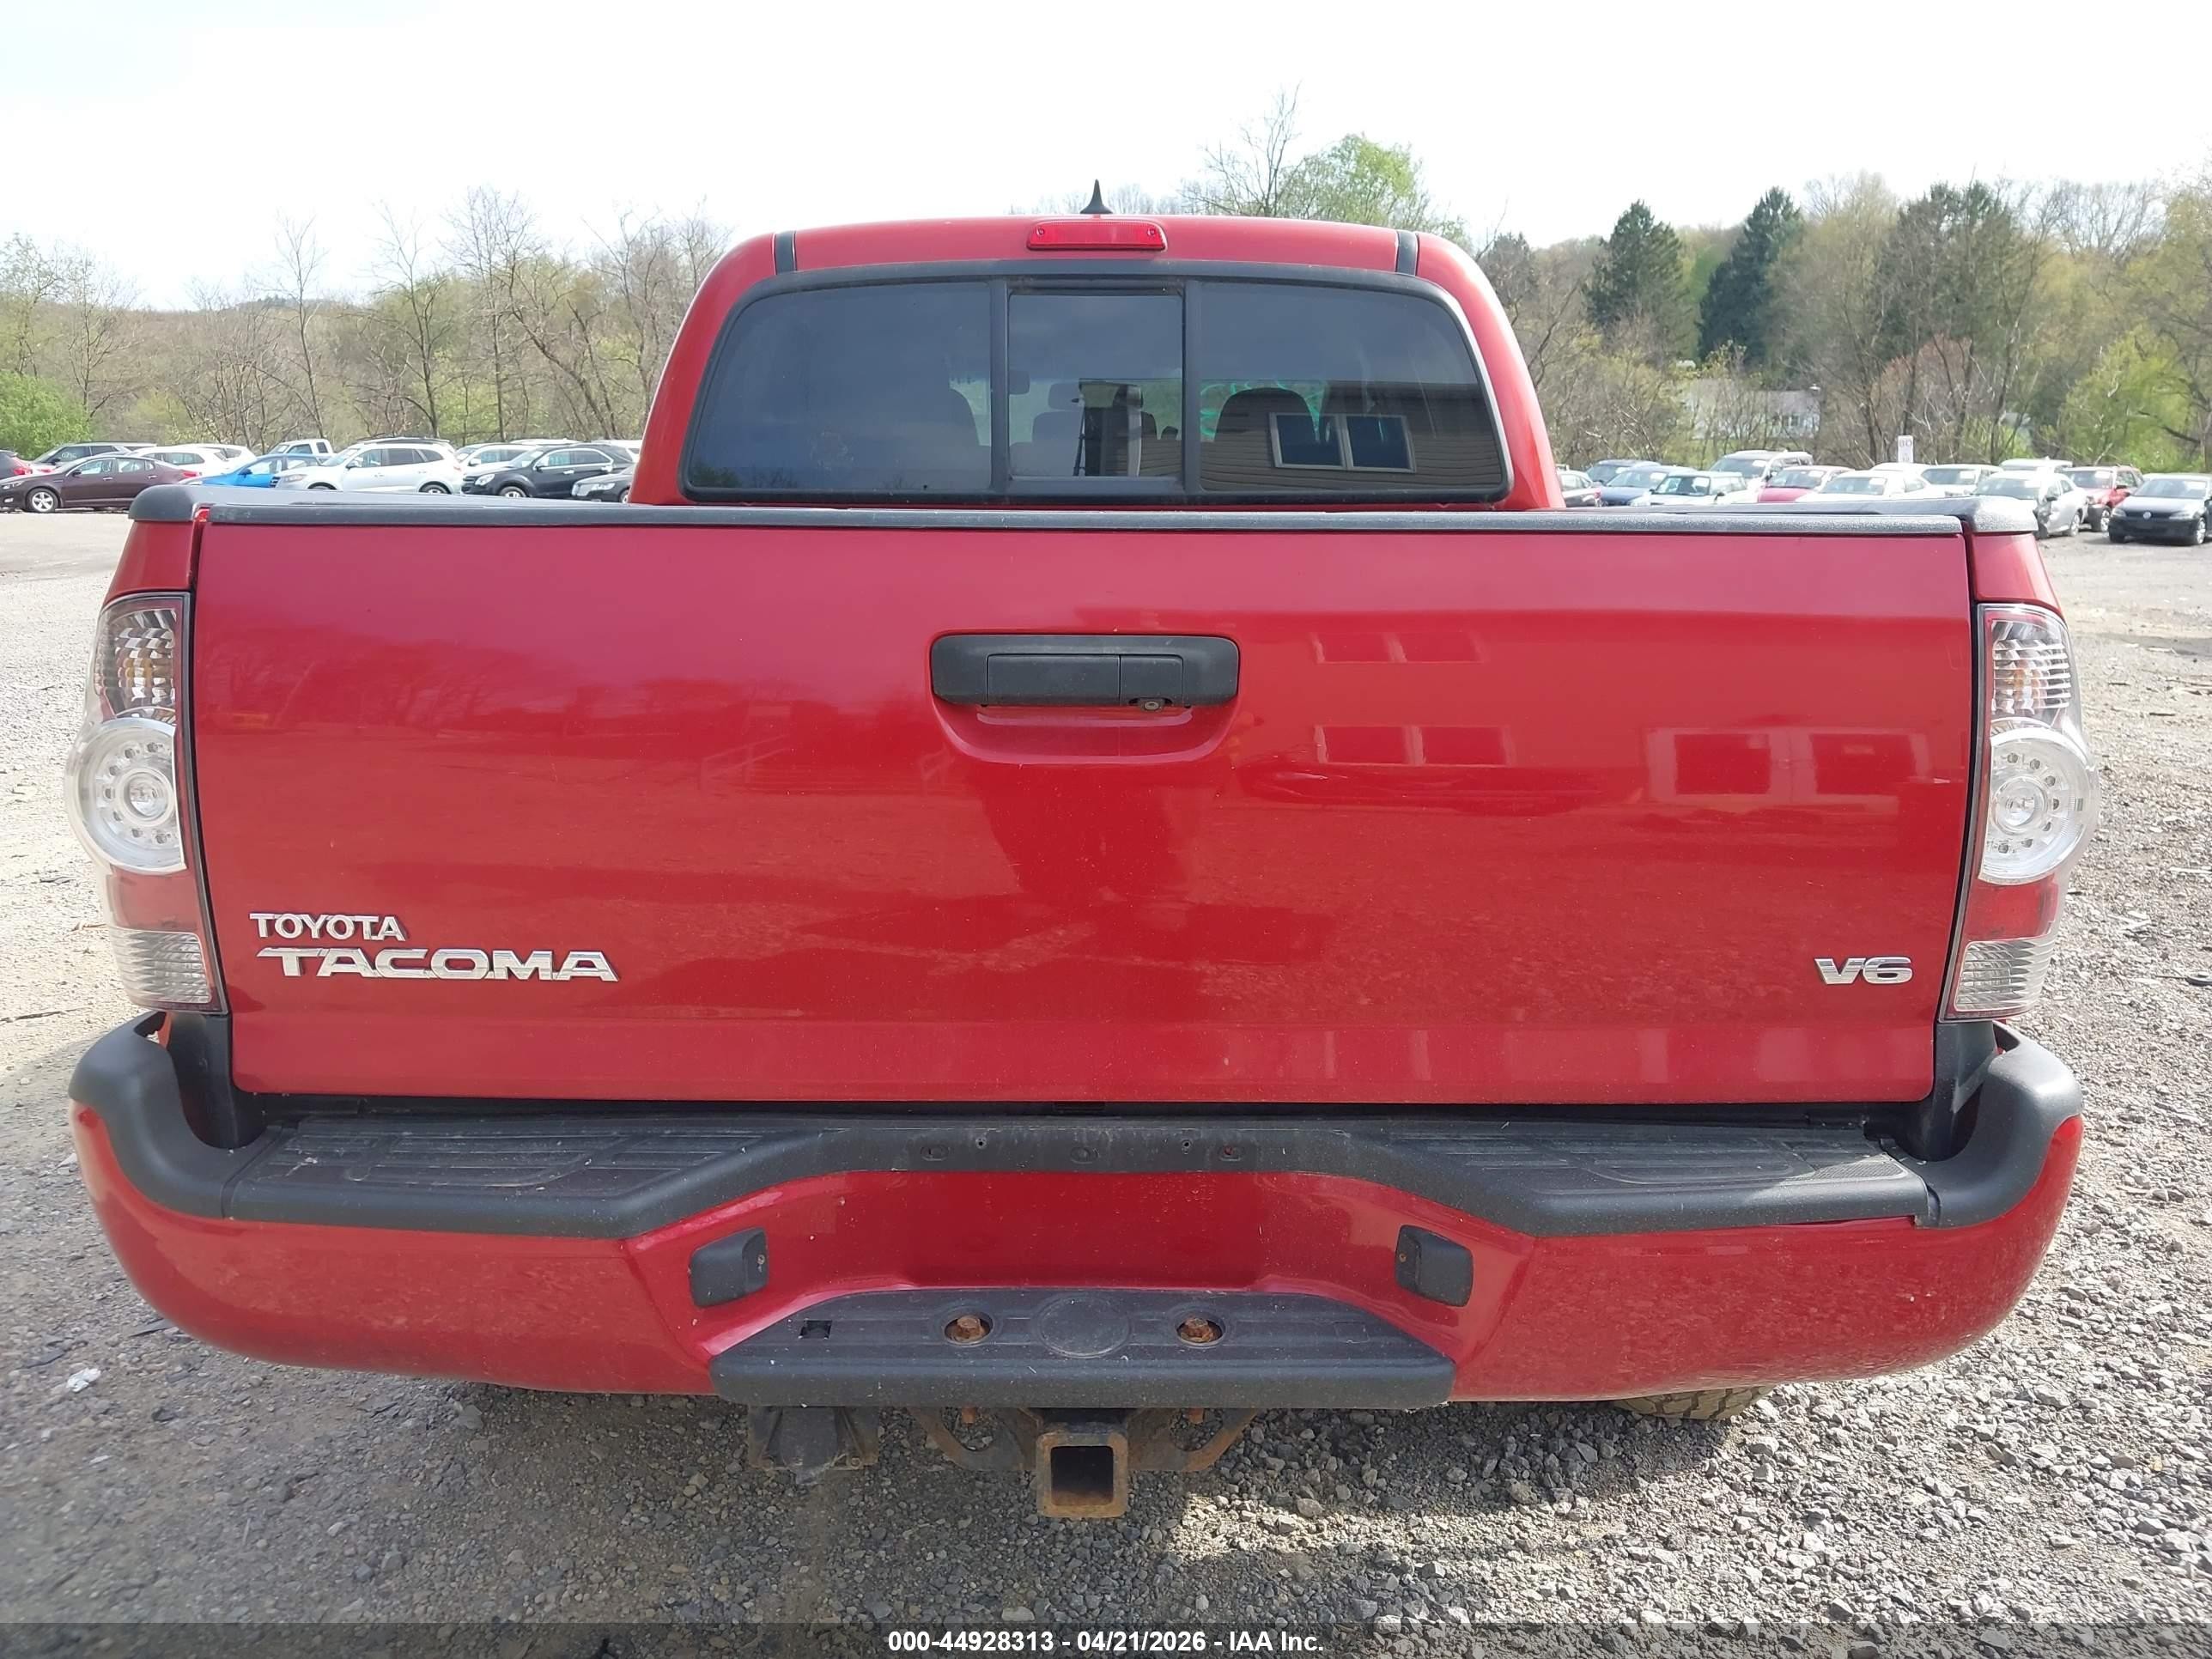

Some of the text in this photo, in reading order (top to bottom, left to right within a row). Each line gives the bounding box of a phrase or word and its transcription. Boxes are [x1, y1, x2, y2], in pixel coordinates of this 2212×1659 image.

[250, 913, 406, 941] TOYOTA
[257, 947, 619, 981] TACOMA
[1814, 957, 1913, 985] V6
